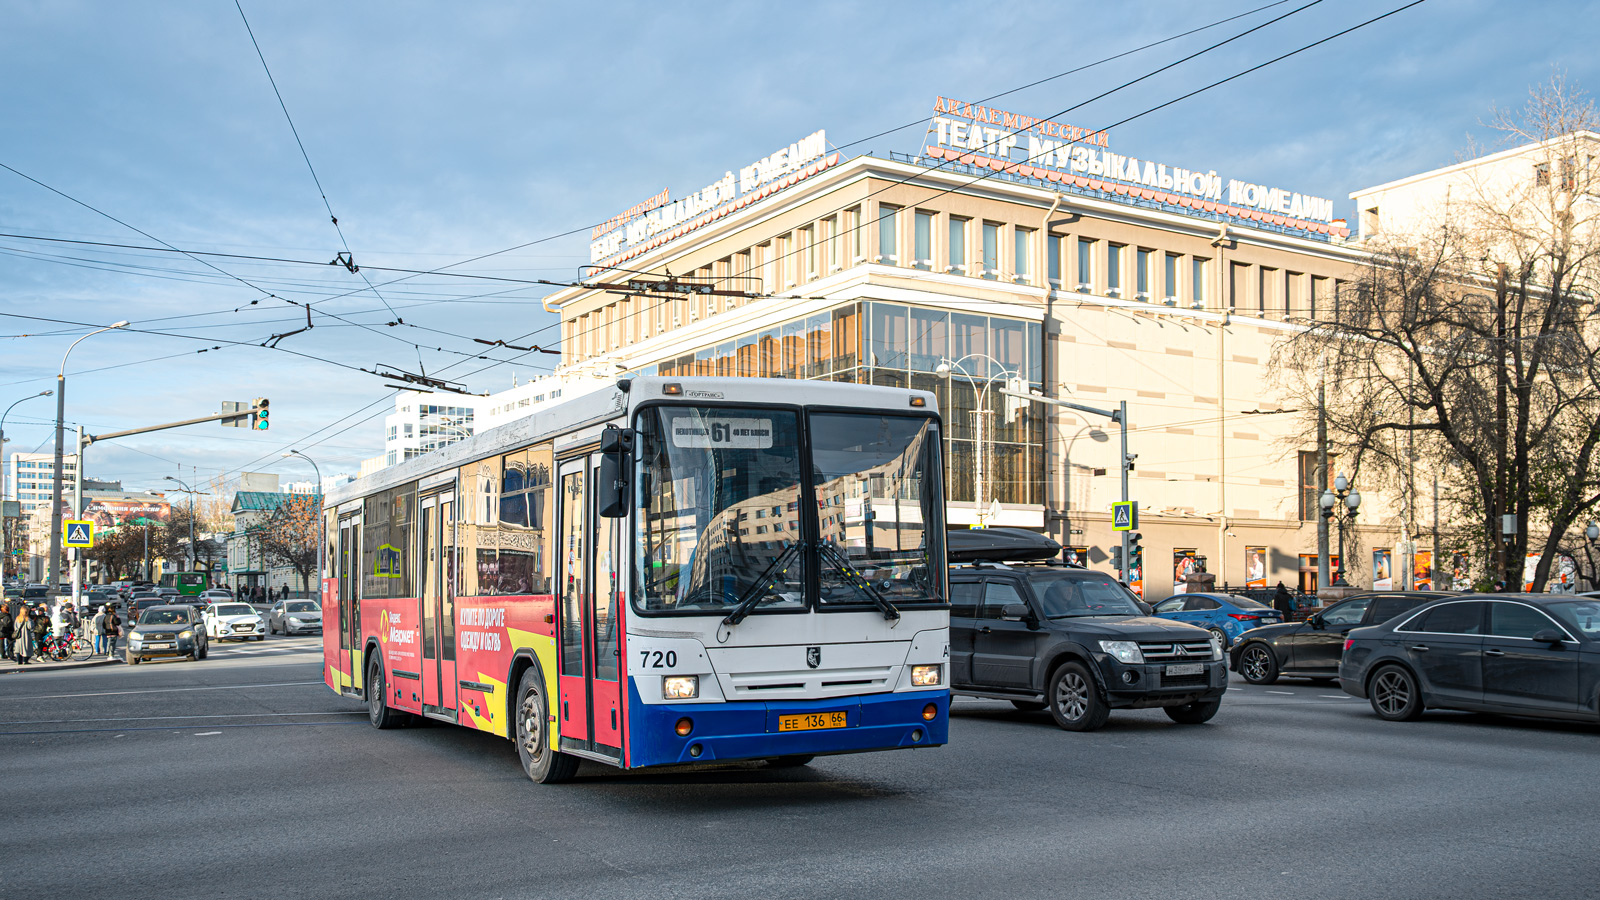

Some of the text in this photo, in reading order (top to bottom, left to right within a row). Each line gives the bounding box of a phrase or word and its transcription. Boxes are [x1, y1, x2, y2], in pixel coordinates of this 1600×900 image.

[934, 96, 1109, 148] АКАДЕМИЧЕСКИЙ
[934, 117, 1334, 222] ТЕАТР МУЗЫКАЛЬНОЙ КОМЕДИИ
[711, 422, 731, 442] 61
[484, 608, 505, 629] ДОРОГЕ
[389, 626, 414, 645] Маркет
[480, 632, 484, 650] И
[484, 632, 501, 651] ОБУВЬ
[640, 650, 677, 668] 720
[942, 645, 950, 657] А
[805, 714, 825, 727] 136
[831, 713, 842, 722] 66
